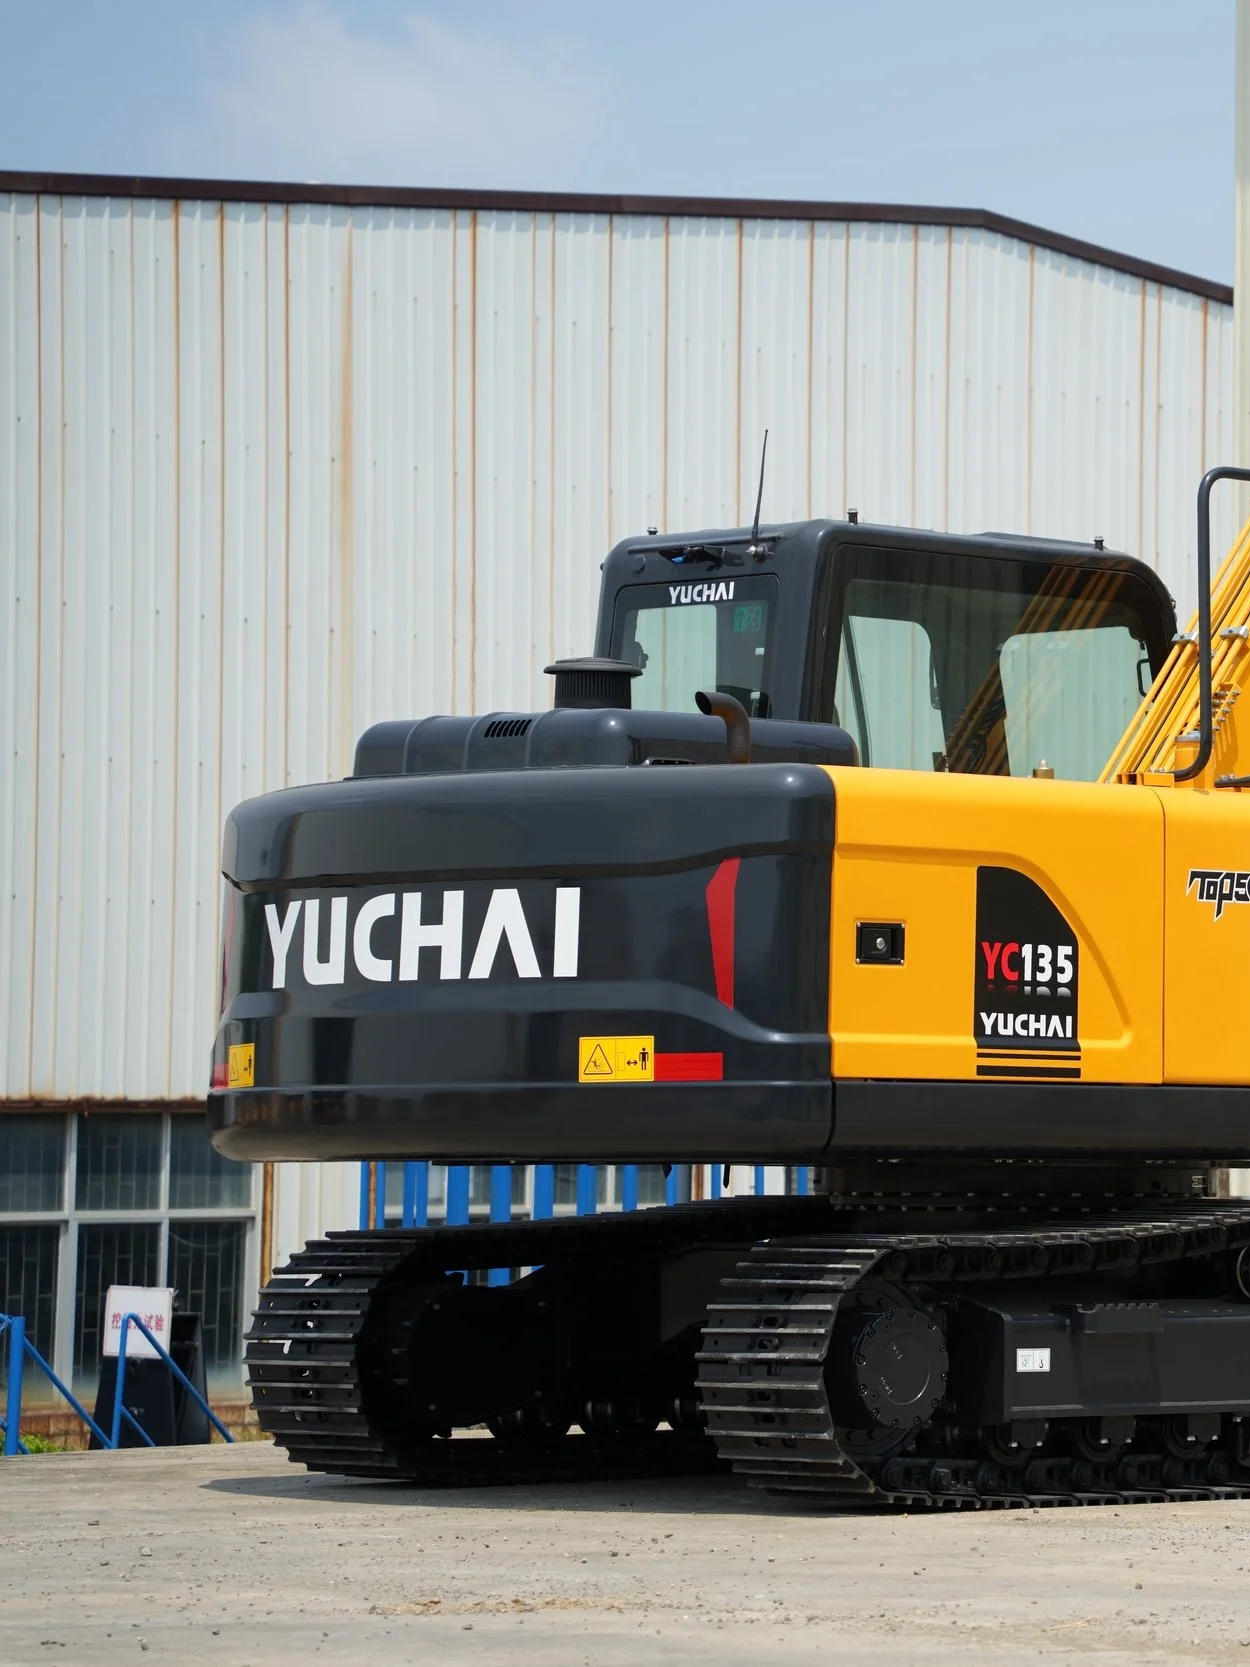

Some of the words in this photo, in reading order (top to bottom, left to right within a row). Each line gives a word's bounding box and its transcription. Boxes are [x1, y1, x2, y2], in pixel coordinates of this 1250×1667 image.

[669, 582, 735, 604] YUCHAI
[264, 887, 581, 989] YUCHAI
[981, 941, 1074, 984] YC135
[979, 1012, 1073, 1038] YUCHAI
